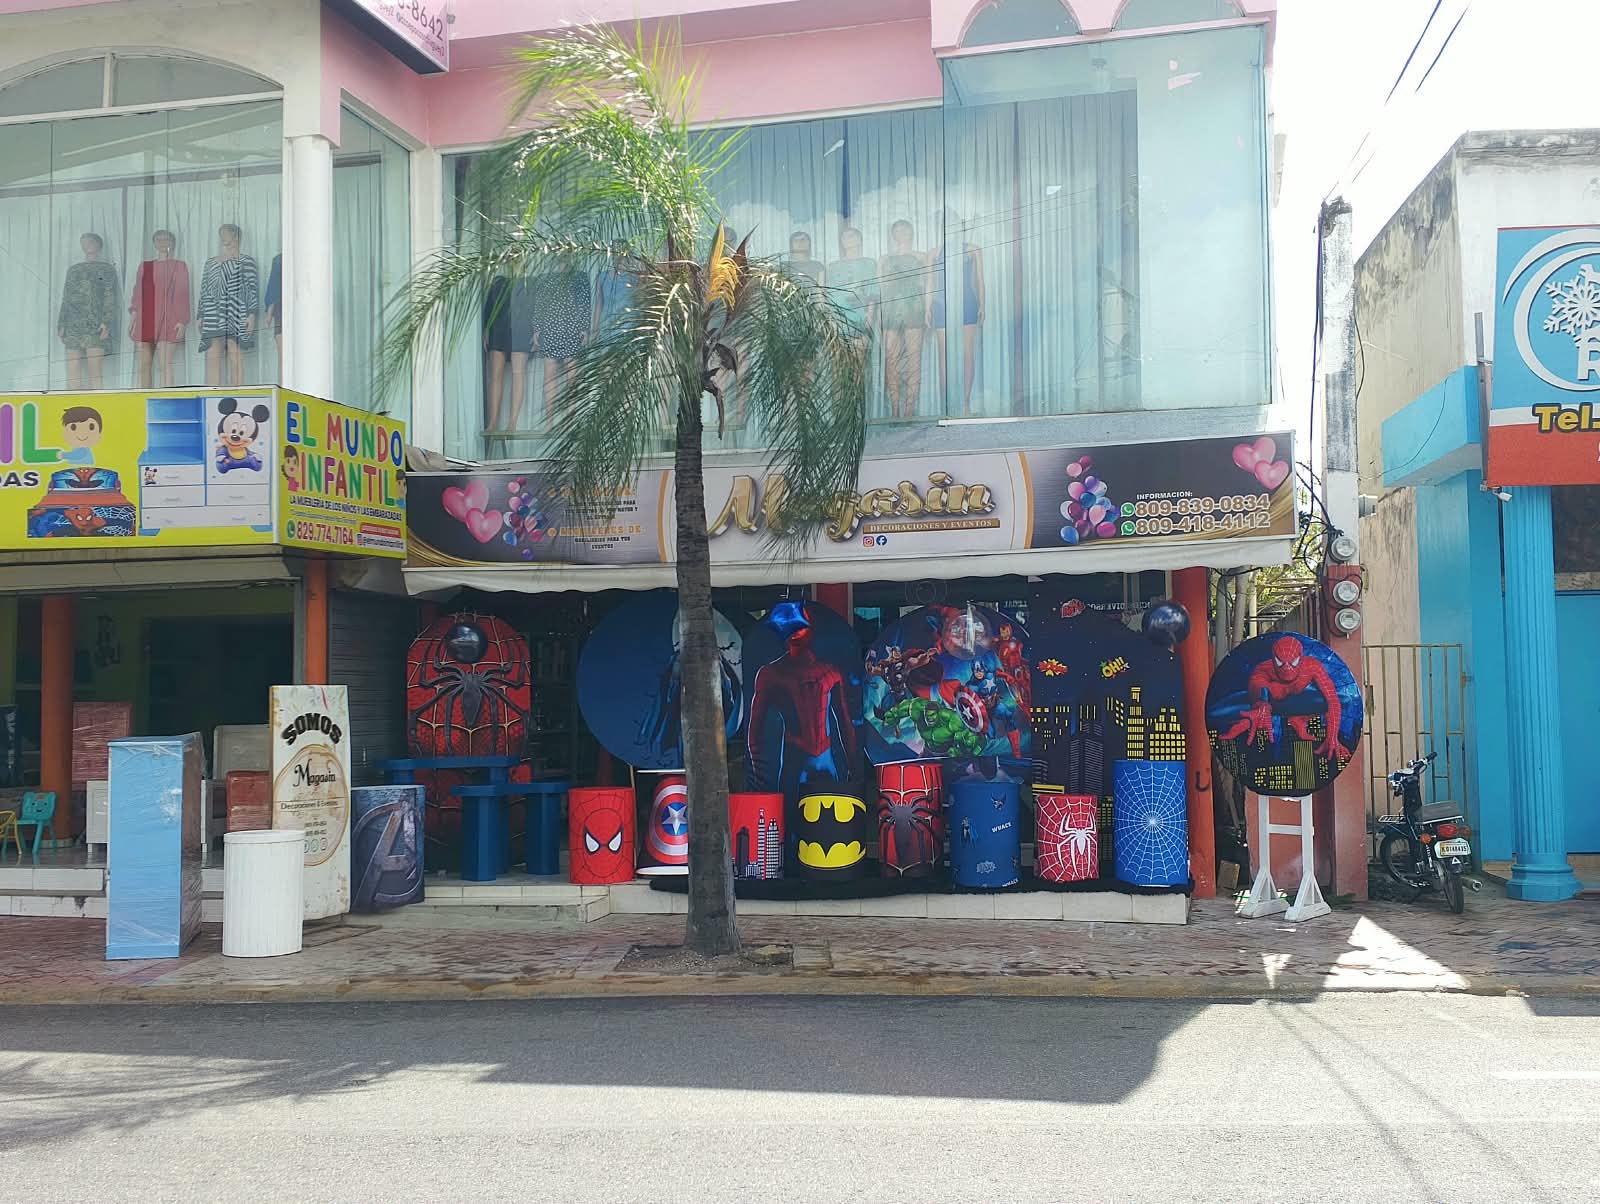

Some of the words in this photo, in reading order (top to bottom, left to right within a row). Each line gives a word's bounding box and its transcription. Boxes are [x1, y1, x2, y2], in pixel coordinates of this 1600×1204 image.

[287, 402, 317, 447] EL
[326, 412, 403, 467] MUNDO
[0, 472, 39, 487] AS
[301, 452, 395, 506] INFANTIL
[1135, 494, 1271, 518] 809-839-0834
[1136, 491, 1193, 501] INFORMACION:
[870, 521, 938, 533] DECORACIONES
[941, 521, 948, 530] Y
[950, 519, 992, 530] EVENTOS
[1135, 511, 1271, 535] 809-418-4112
[282, 712, 343, 746] SOMOS
[292, 757, 337, 788] Magasin
